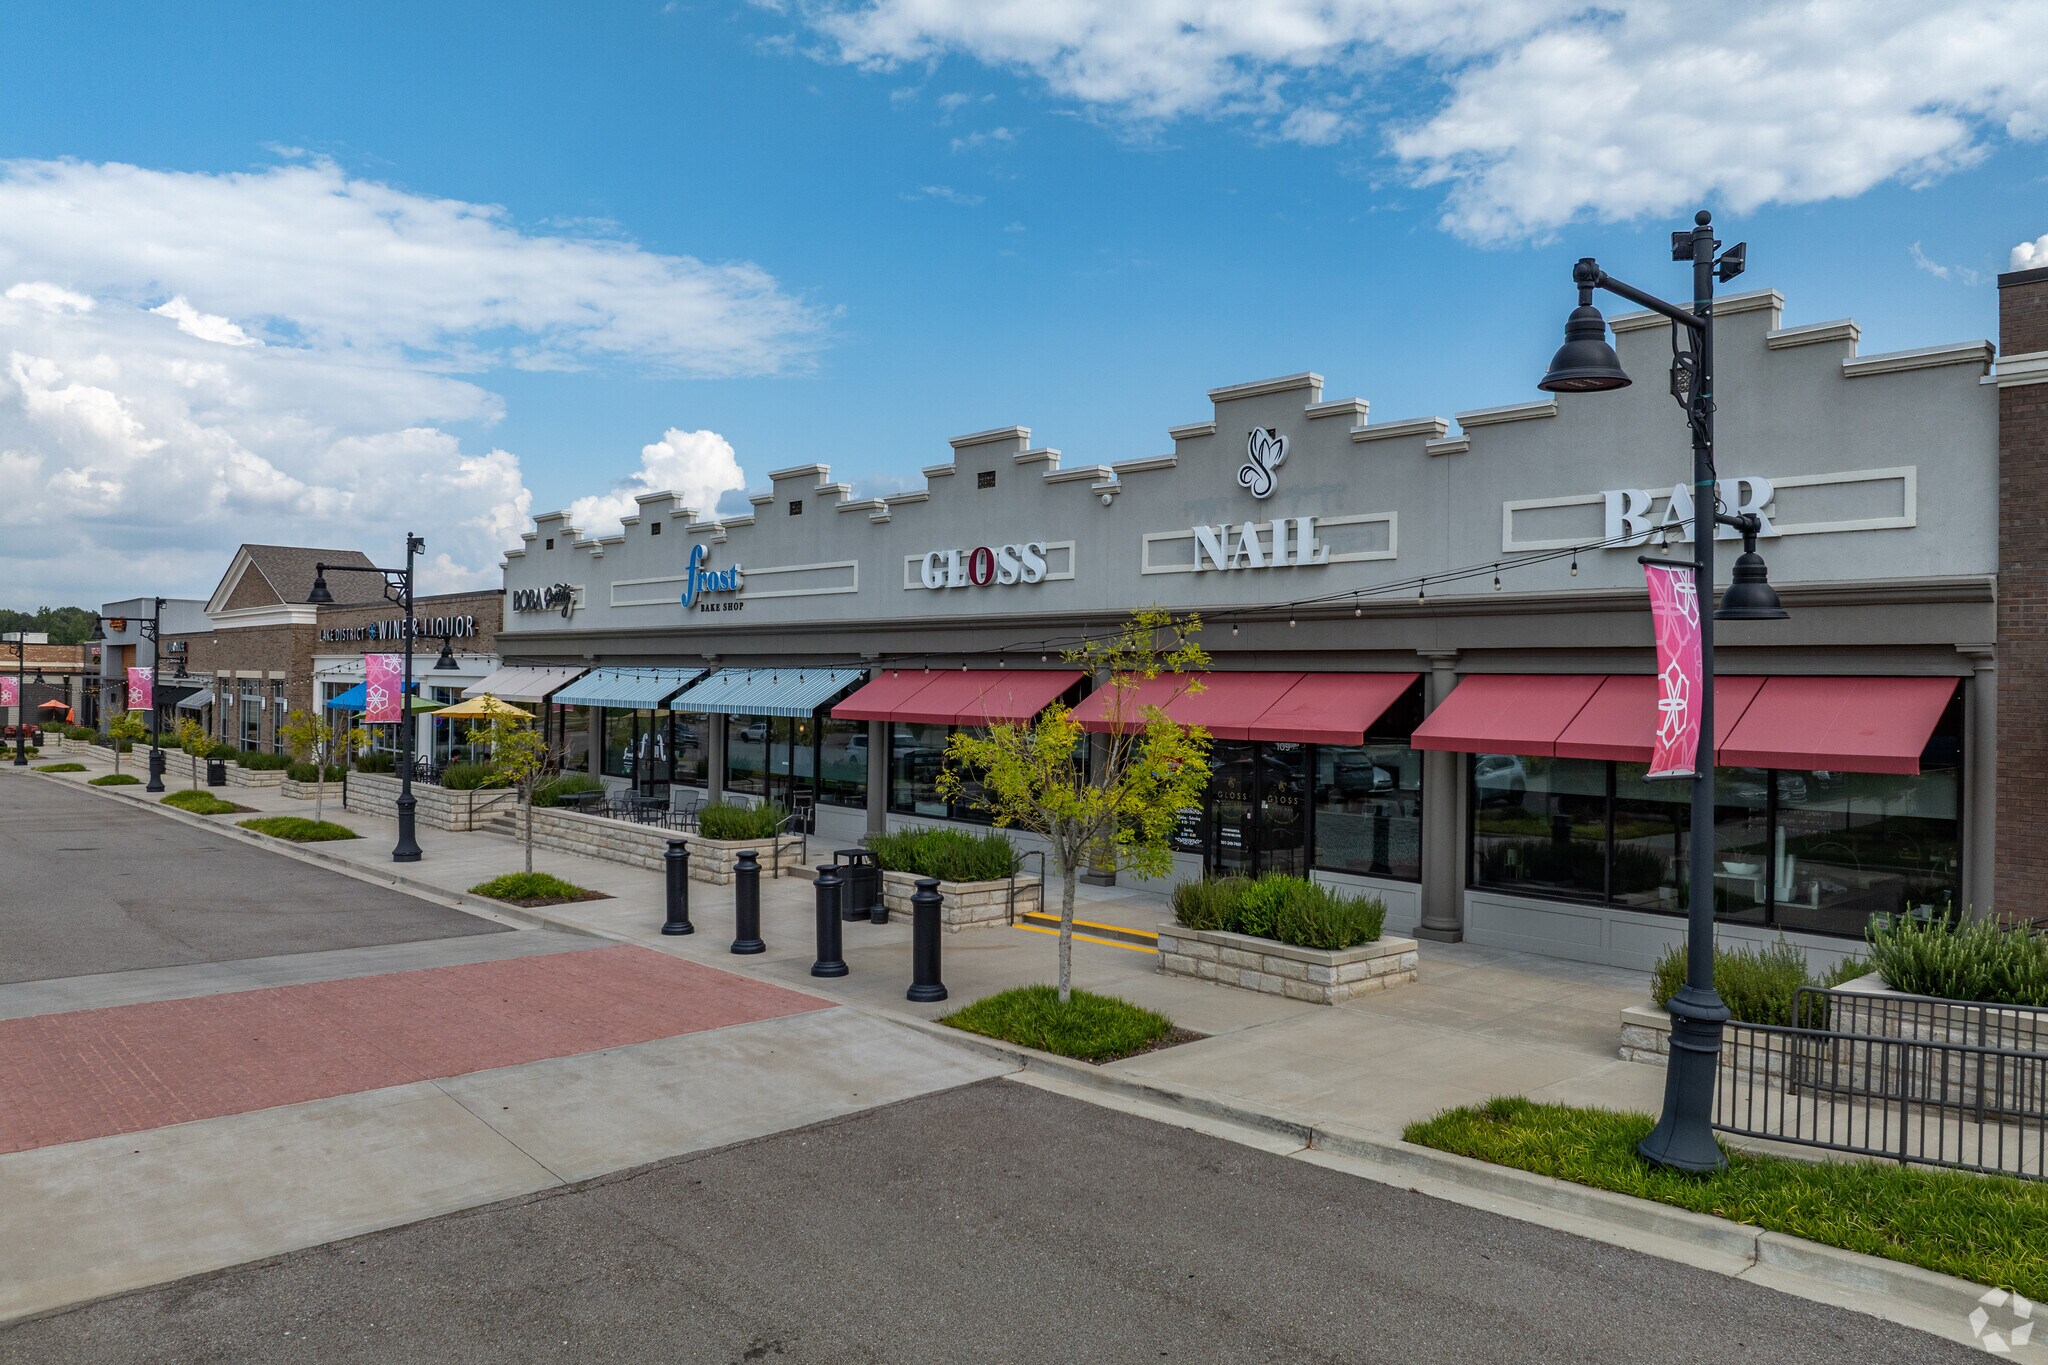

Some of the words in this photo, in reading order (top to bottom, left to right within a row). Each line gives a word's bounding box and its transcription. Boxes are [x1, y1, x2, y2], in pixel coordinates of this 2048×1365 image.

[1599, 477, 1782, 548] BAR
[1191, 516, 1330, 571] NAIL
[681, 544, 742, 608] frost
[921, 542, 1047, 589] GLOSS
[513, 588, 545, 611] BOBA
[700, 603, 720, 612] BAKE
[723, 602, 744, 611] SHOP
[319, 629, 334, 642] LAKE
[335, 627, 365, 641] DISTRICT
[378, 619, 407, 640] WINE
[412, 617, 419, 638] &
[1276, 742, 1291, 752] 109
[1217, 790, 1247, 801] GLOSS
[1267, 794, 1299, 805] GLOSS
